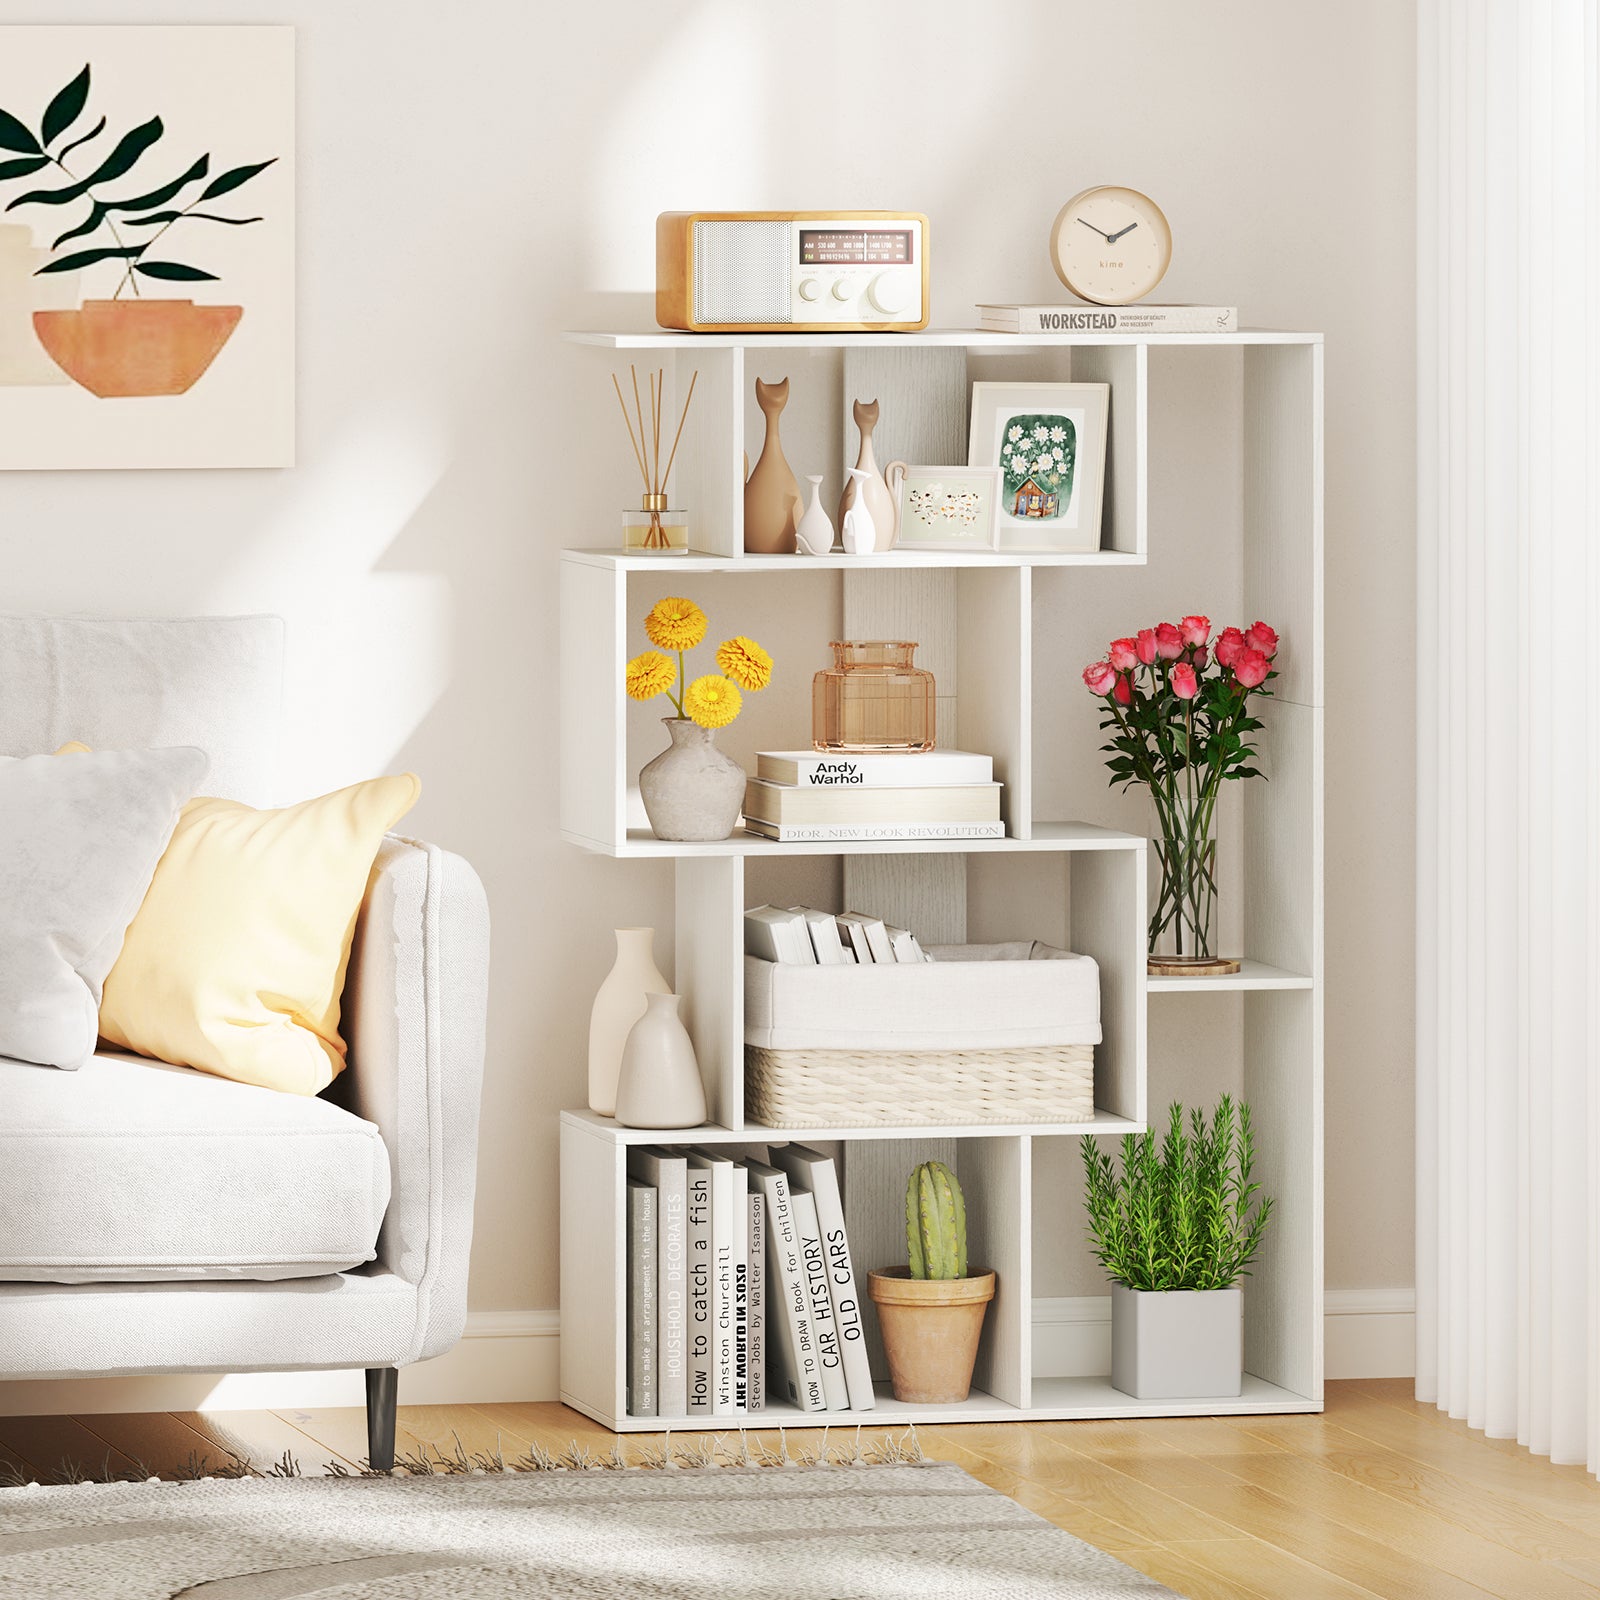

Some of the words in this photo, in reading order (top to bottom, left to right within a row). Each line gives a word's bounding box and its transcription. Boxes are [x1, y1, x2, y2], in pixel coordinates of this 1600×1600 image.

[1099, 260, 1124, 268] kime
[1040, 313, 1117, 329] WORKSTEAD
[809, 773, 863, 784] Warhol
[816, 762, 857, 775] Andy
[829, 829, 860, 837] NEW
[865, 828, 903, 837] LOOK
[908, 827, 998, 836] REVOLUTION
[642, 1192, 651, 1221] house
[690, 1180, 707, 1226] fish
[776, 1180, 792, 1242] children
[642, 1225, 651, 1242] the
[668, 1194, 680, 1280] DECORATES
[752, 1196, 760, 1254] Isaacson
[642, 1248, 650, 1260] in
[694, 1240, 707, 1250] a
[827, 1230, 851, 1284] CARS
[787, 1251, 797, 1273] for
[690, 1264, 707, 1322] catch
[719, 1246, 729, 1329] Churchill
[751, 1263, 760, 1307] Walter
[802, 1237, 831, 1320] HISTORY
[643, 1264, 652, 1326] arrangement
[790, 1281, 804, 1312] Book
[668, 1290, 681, 1378] HOUSEHOLD
[751, 1314, 762, 1328] by
[840, 1300, 861, 1340] OLD
[644, 1331, 651, 1342] an
[691, 1335, 707, 1358] to
[751, 1336, 760, 1364] Jobs
[797, 1320, 811, 1351] DRAW
[819, 1332, 839, 1368] CAR
[642, 1348, 651, 1370] make
[719, 1339, 729, 1404] Winston
[804, 1358, 815, 1375] TO
[643, 1375, 651, 1386] to
[691, 1370, 707, 1405] How
[752, 1372, 760, 1408] Steve
[808, 1382, 821, 1405] HOW
[642, 1391, 651, 1409] How
